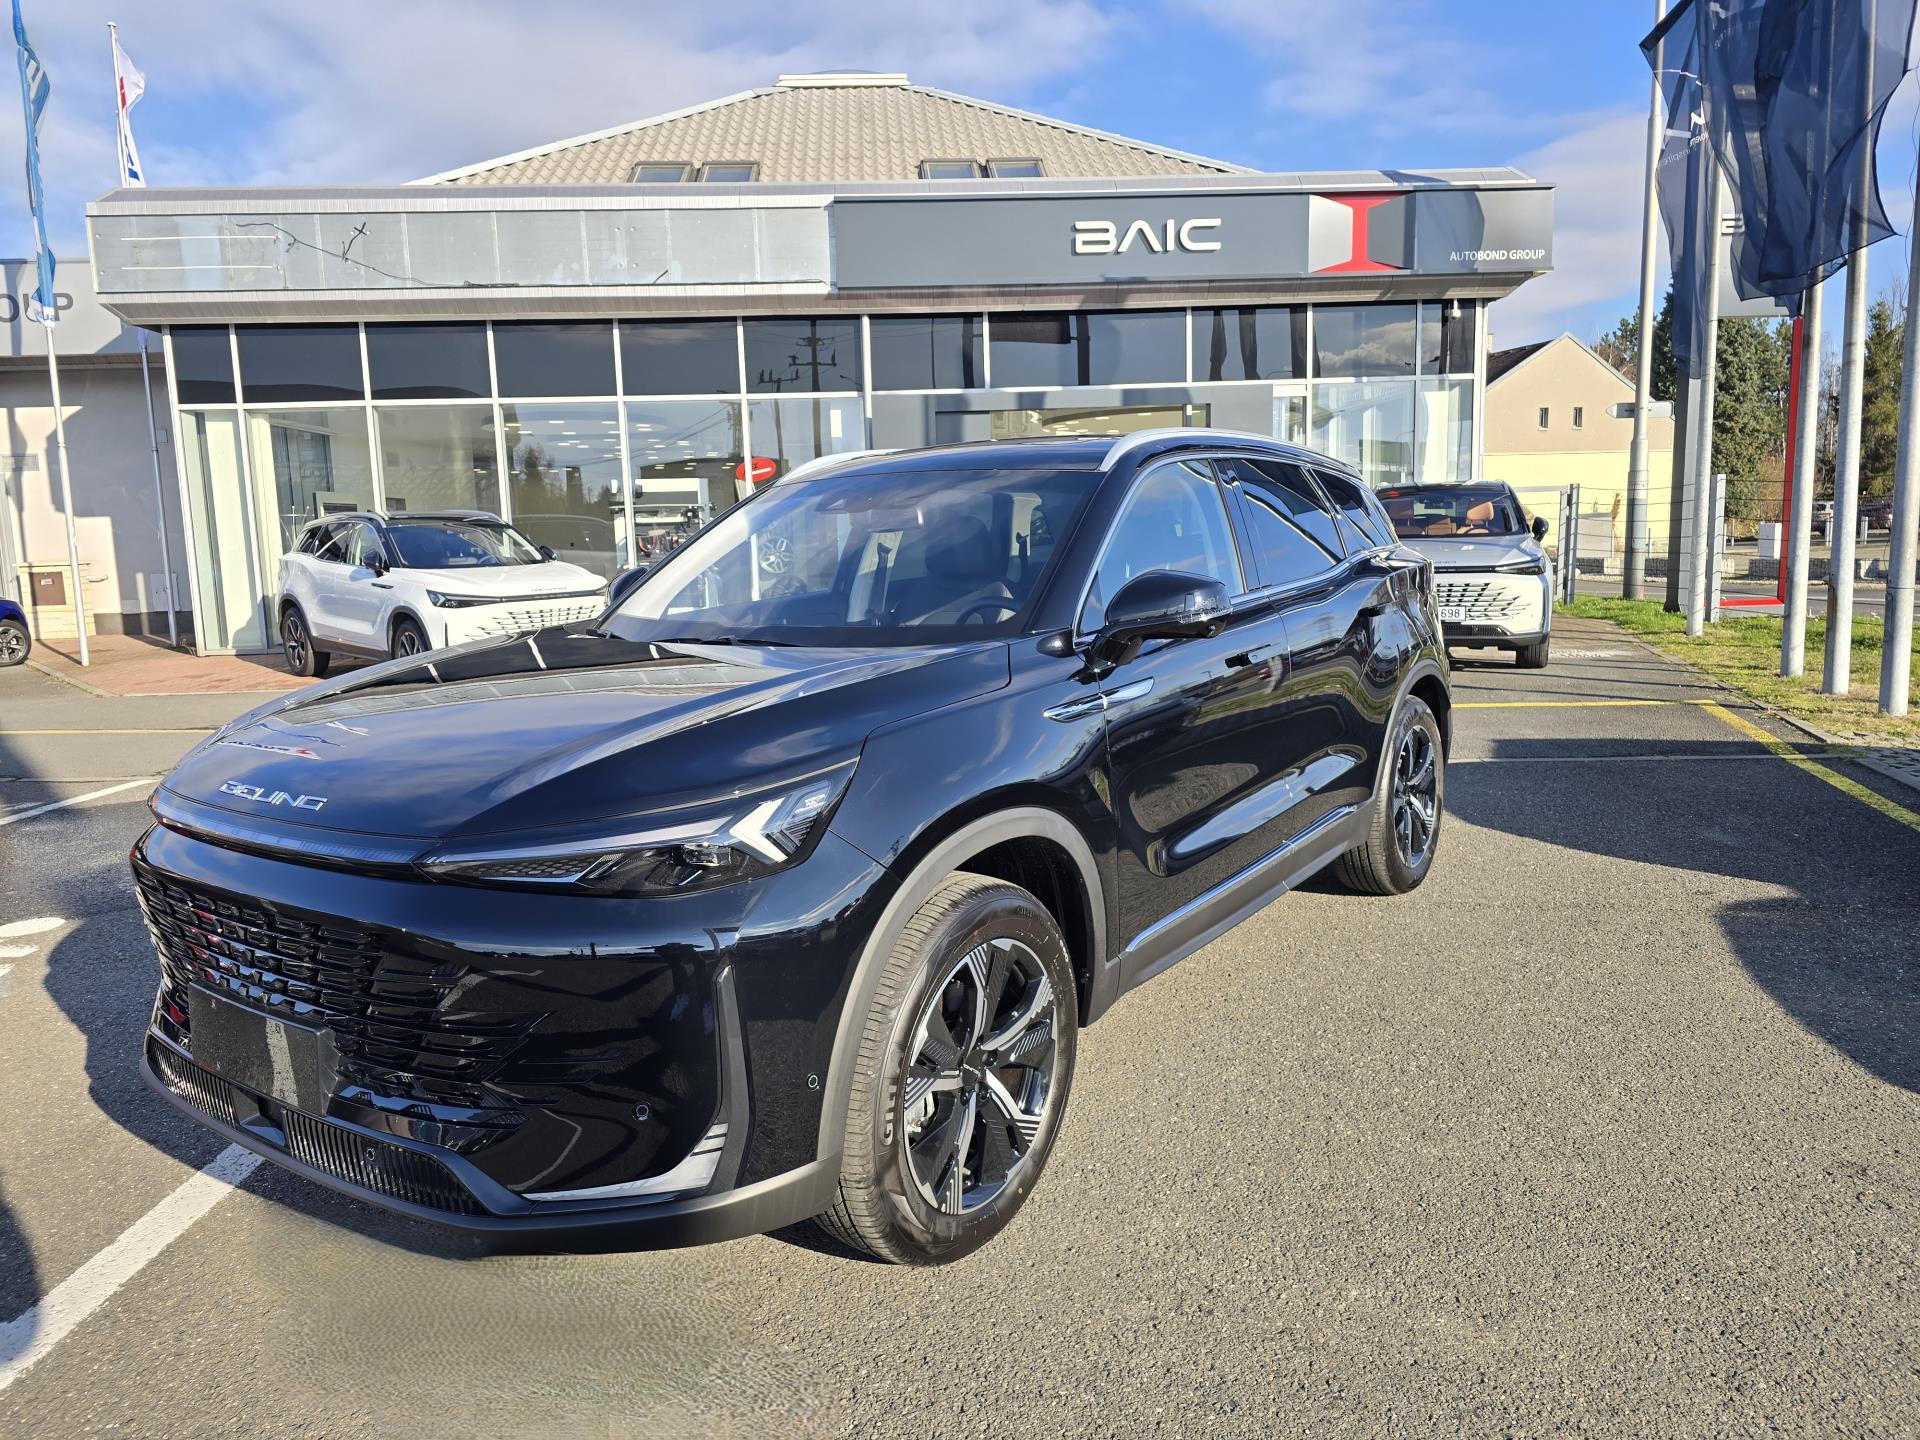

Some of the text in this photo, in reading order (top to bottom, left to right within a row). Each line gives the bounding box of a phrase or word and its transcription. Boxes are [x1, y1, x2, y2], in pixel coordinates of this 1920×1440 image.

[1074, 217, 1222, 254] BAIC
[1449, 249, 1546, 261] AUTOBOND GROUP
[218, 779, 329, 812] BEIJING
